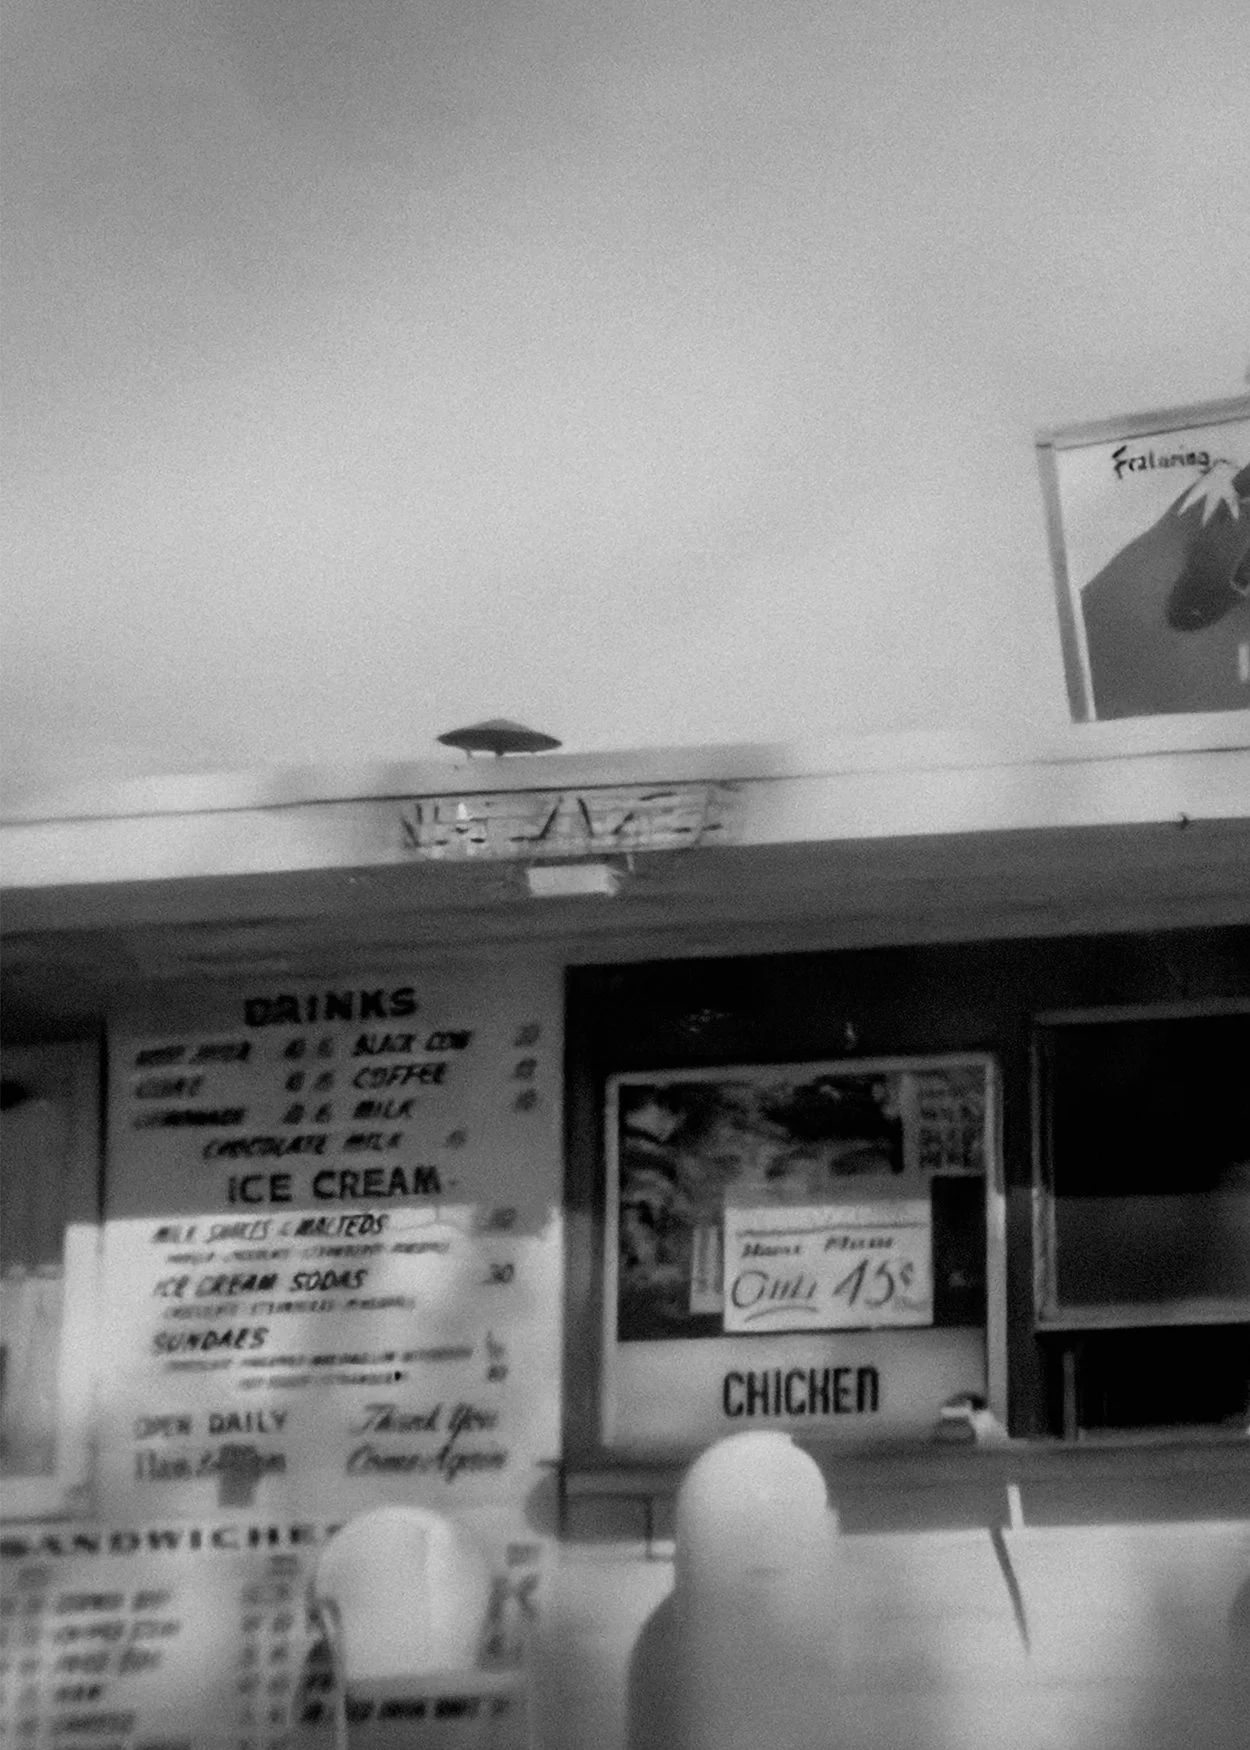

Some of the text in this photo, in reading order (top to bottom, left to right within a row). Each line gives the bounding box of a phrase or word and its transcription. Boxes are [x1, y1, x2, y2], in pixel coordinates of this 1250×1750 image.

[245, 986, 418, 1027] DRINKS
[353, 1062, 447, 1089] COFFEE
[228, 1166, 442, 1203] ICE CREAM
[290, 1268, 369, 1292] SODAS
[153, 1326, 270, 1351] SUNDAES
[722, 1365, 880, 1418] CHICKEN
[208, 1409, 288, 1435] DAILY
